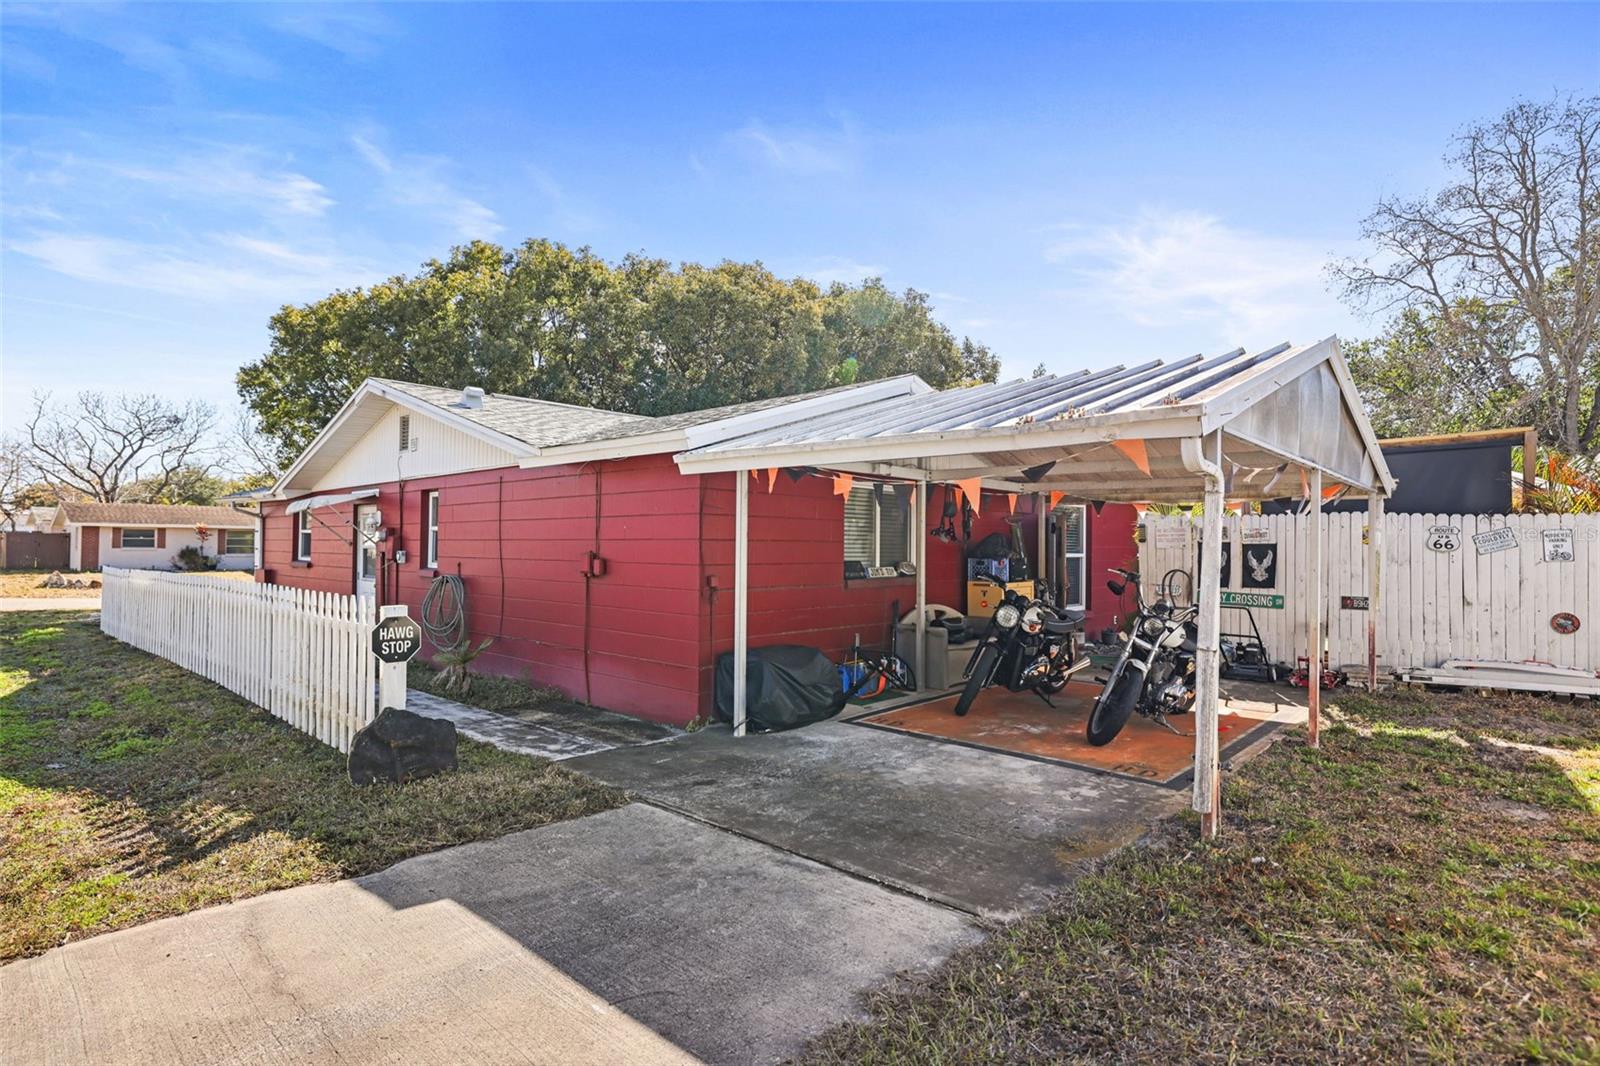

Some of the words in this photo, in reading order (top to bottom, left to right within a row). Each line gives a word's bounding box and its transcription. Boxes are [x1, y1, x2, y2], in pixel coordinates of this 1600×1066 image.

[1433, 539, 1454, 550] 66
[1230, 593, 1273, 607] CROSSING
[380, 626, 414, 640] HAWG
[382, 640, 411, 655] STOP
